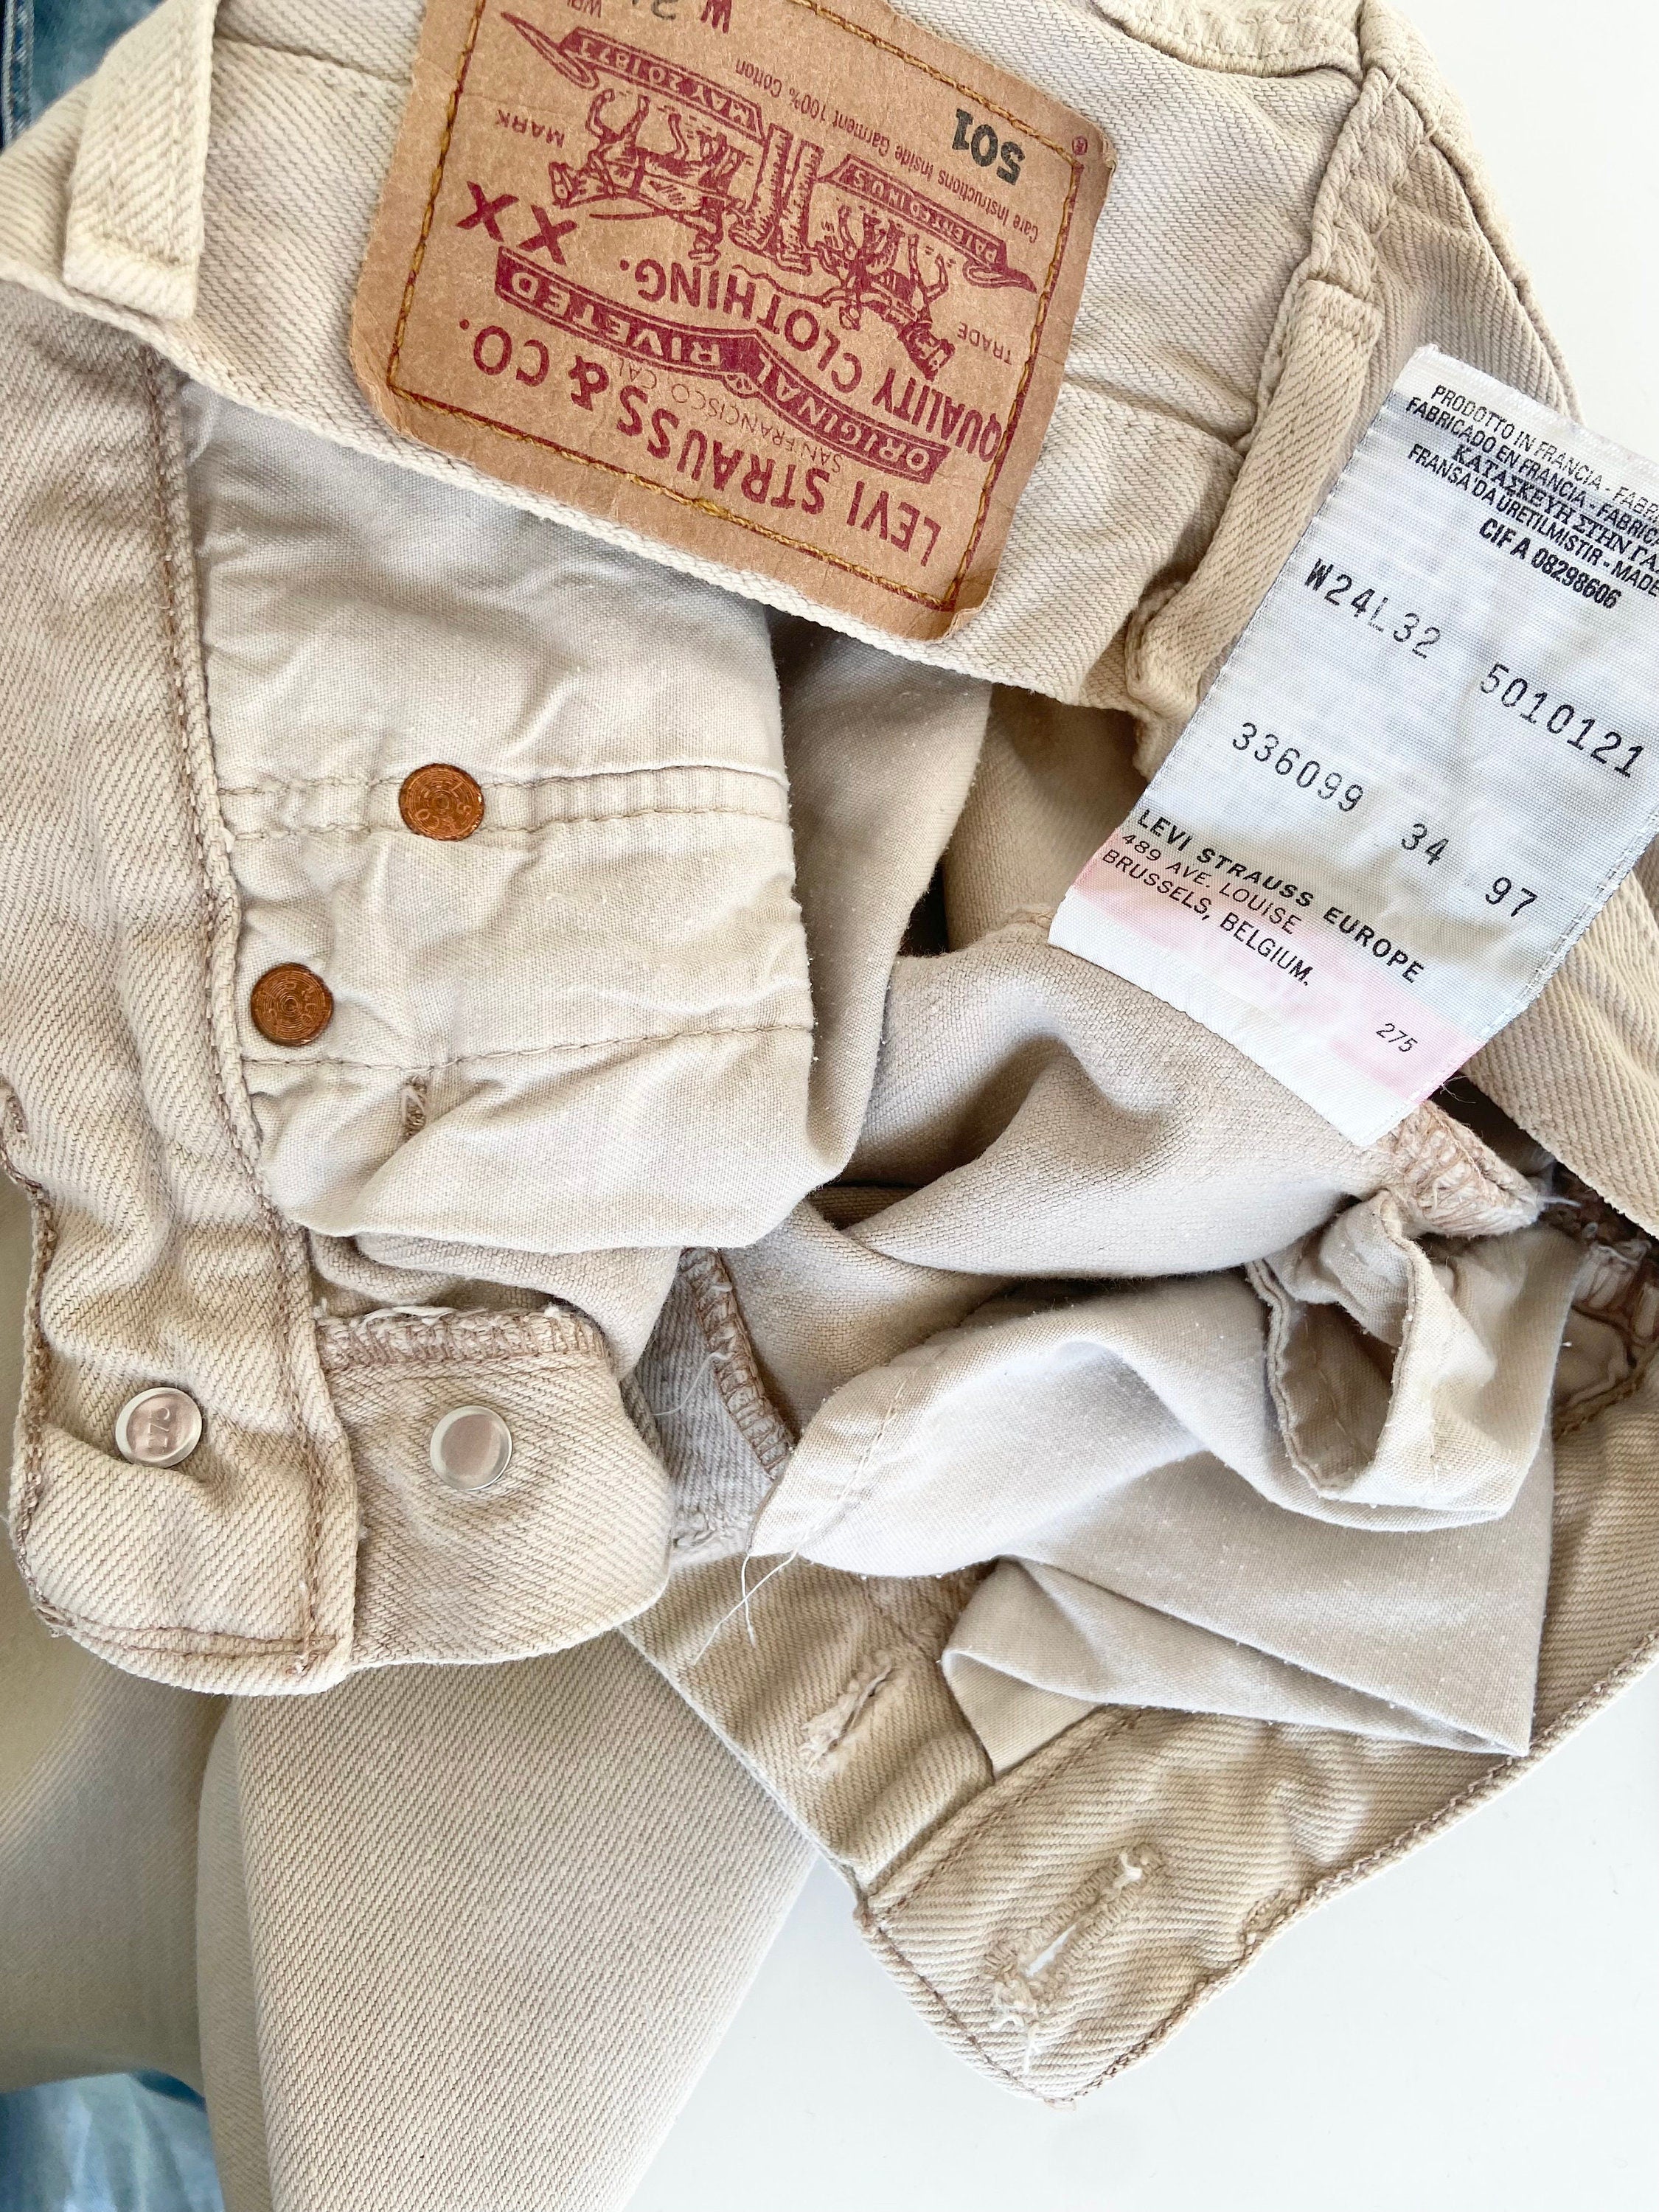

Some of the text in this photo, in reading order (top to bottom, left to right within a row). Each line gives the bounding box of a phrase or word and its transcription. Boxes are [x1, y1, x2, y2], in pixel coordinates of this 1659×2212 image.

[495, 109, 566, 147] MARK
[581, 39, 750, 127] MAY 20 1873
[735, 58, 1038, 243] Care Instructions Inside Garment 100% Cotton
[952, 108, 1026, 186] 501
[511, 271, 931, 472] ORIGINAL RIVETED
[619, 258, 1003, 463] QUALITY CLOTHING.
[957, 321, 1012, 366] TRADE
[459, 319, 942, 566] LEVI STRAUSS & CO.
[803, 439, 843, 473] SAN
[1405, 396, 1497, 453] FABRICADO
[1495, 445, 1521, 468] EN
[1518, 457, 1587, 508] FRANCIA
[1430, 384, 1514, 439] PRODOTTO
[1513, 431, 1537, 452] IN
[1534, 441, 1603, 491] FRANCIA
[1479, 518, 1621, 609] CIF A 08298606
[1627, 544, 1659, 574] ΓΑ
[1304, 557, 1644, 779] W24L32 5010121
[1232, 722, 1538, 918] 336099 34 97
[1102, 849, 1315, 987] BRUSSELS, BELGIUM.
[1121, 833, 1303, 936] 489 AVE. LOUISE
[1136, 809, 1425, 984] LEVI STRAUSS EUROPE
[1376, 1023, 1419, 1054] 275
